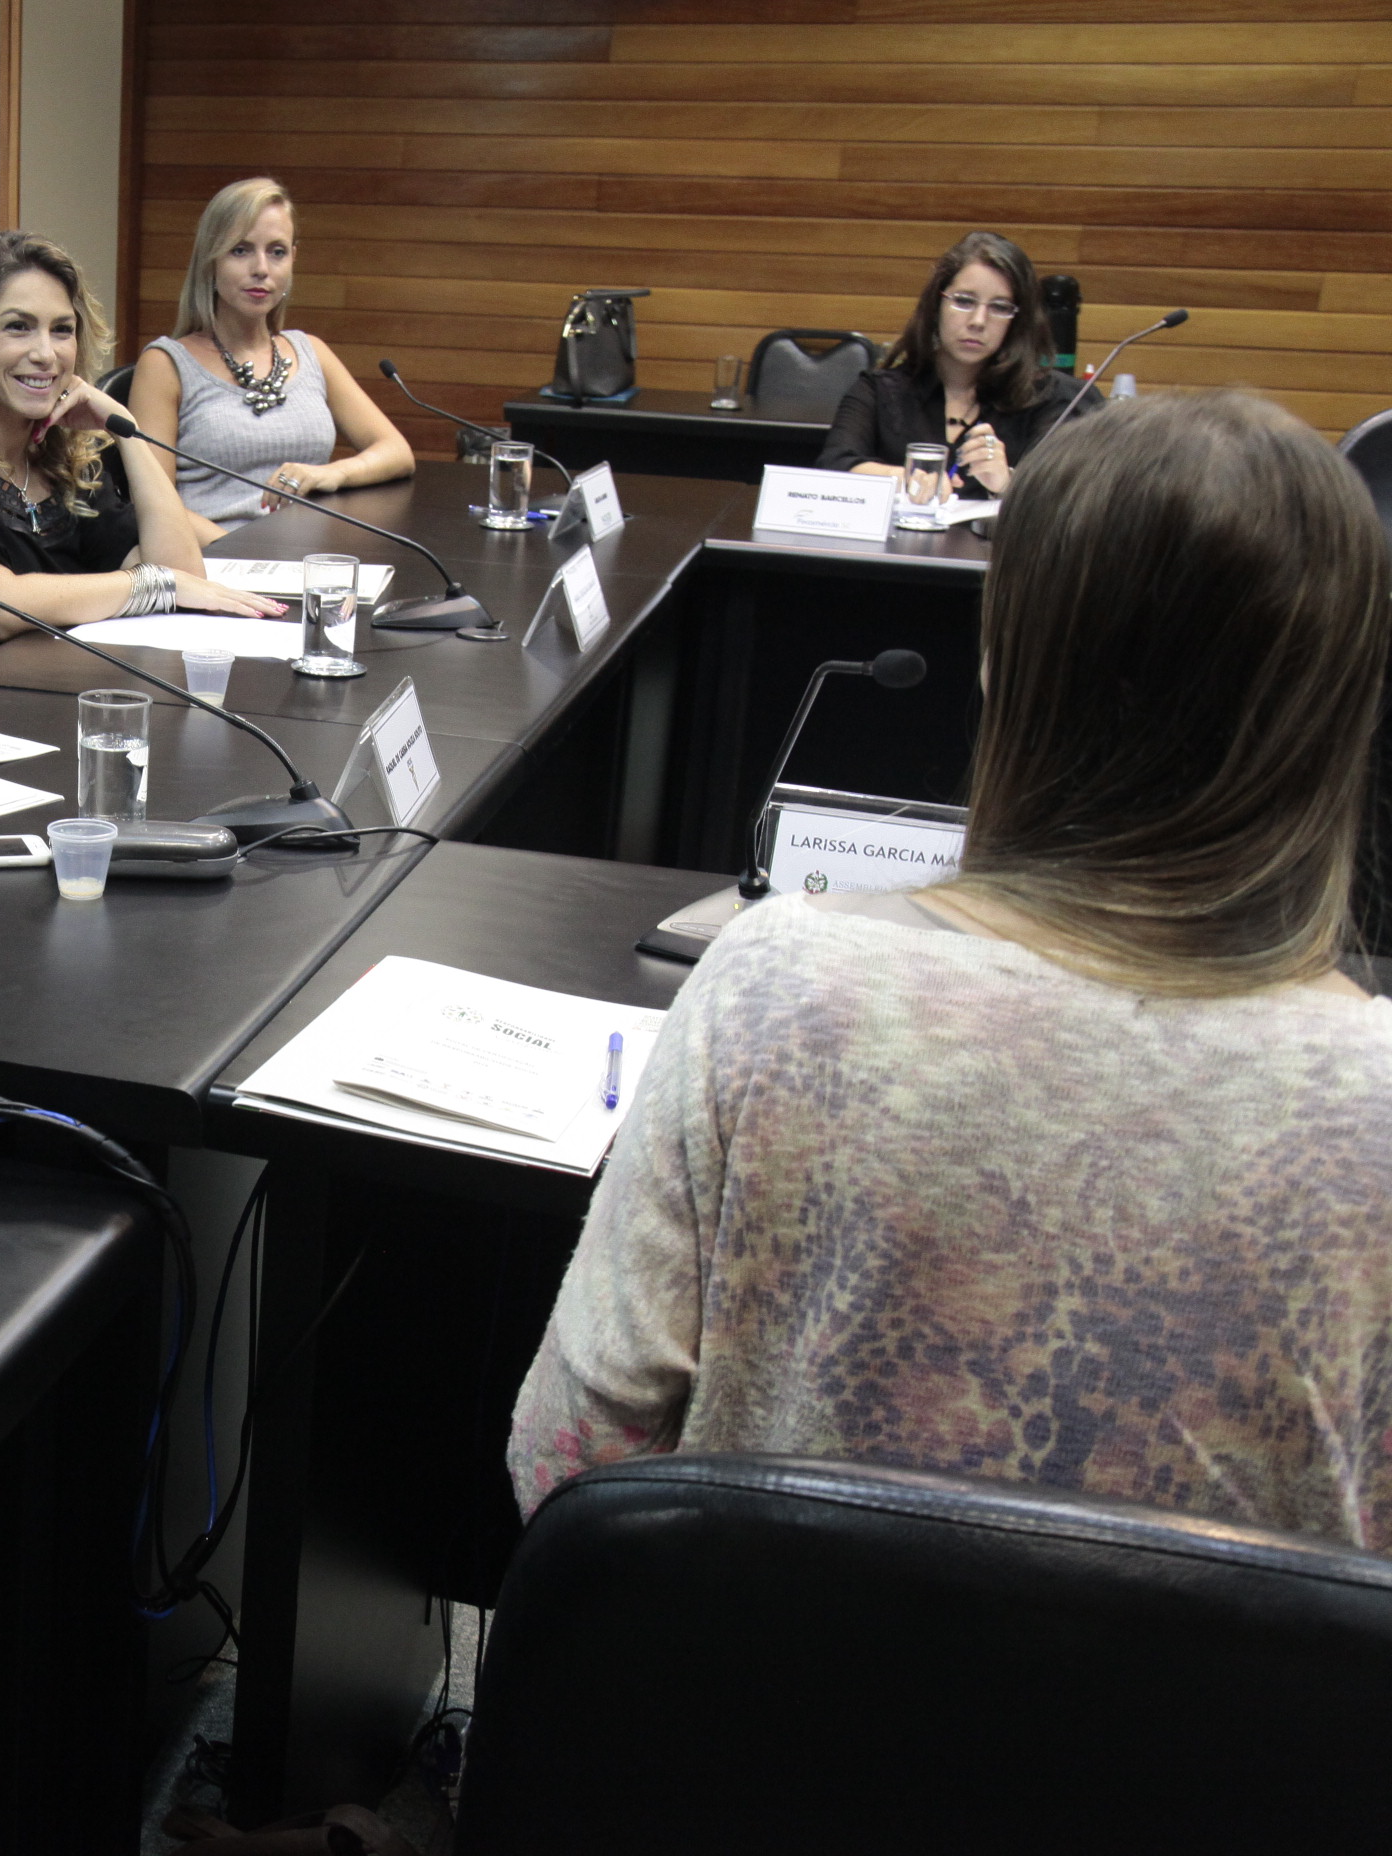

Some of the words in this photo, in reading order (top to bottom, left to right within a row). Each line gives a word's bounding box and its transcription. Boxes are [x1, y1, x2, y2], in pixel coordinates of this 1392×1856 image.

[787, 491, 818, 500] RENATO
[820, 494, 866, 505] BARCELLOS
[790, 834, 858, 855] LARISSA
[863, 843, 926, 864] GARCIA
[491, 1023, 551, 1050] SOCIAL
